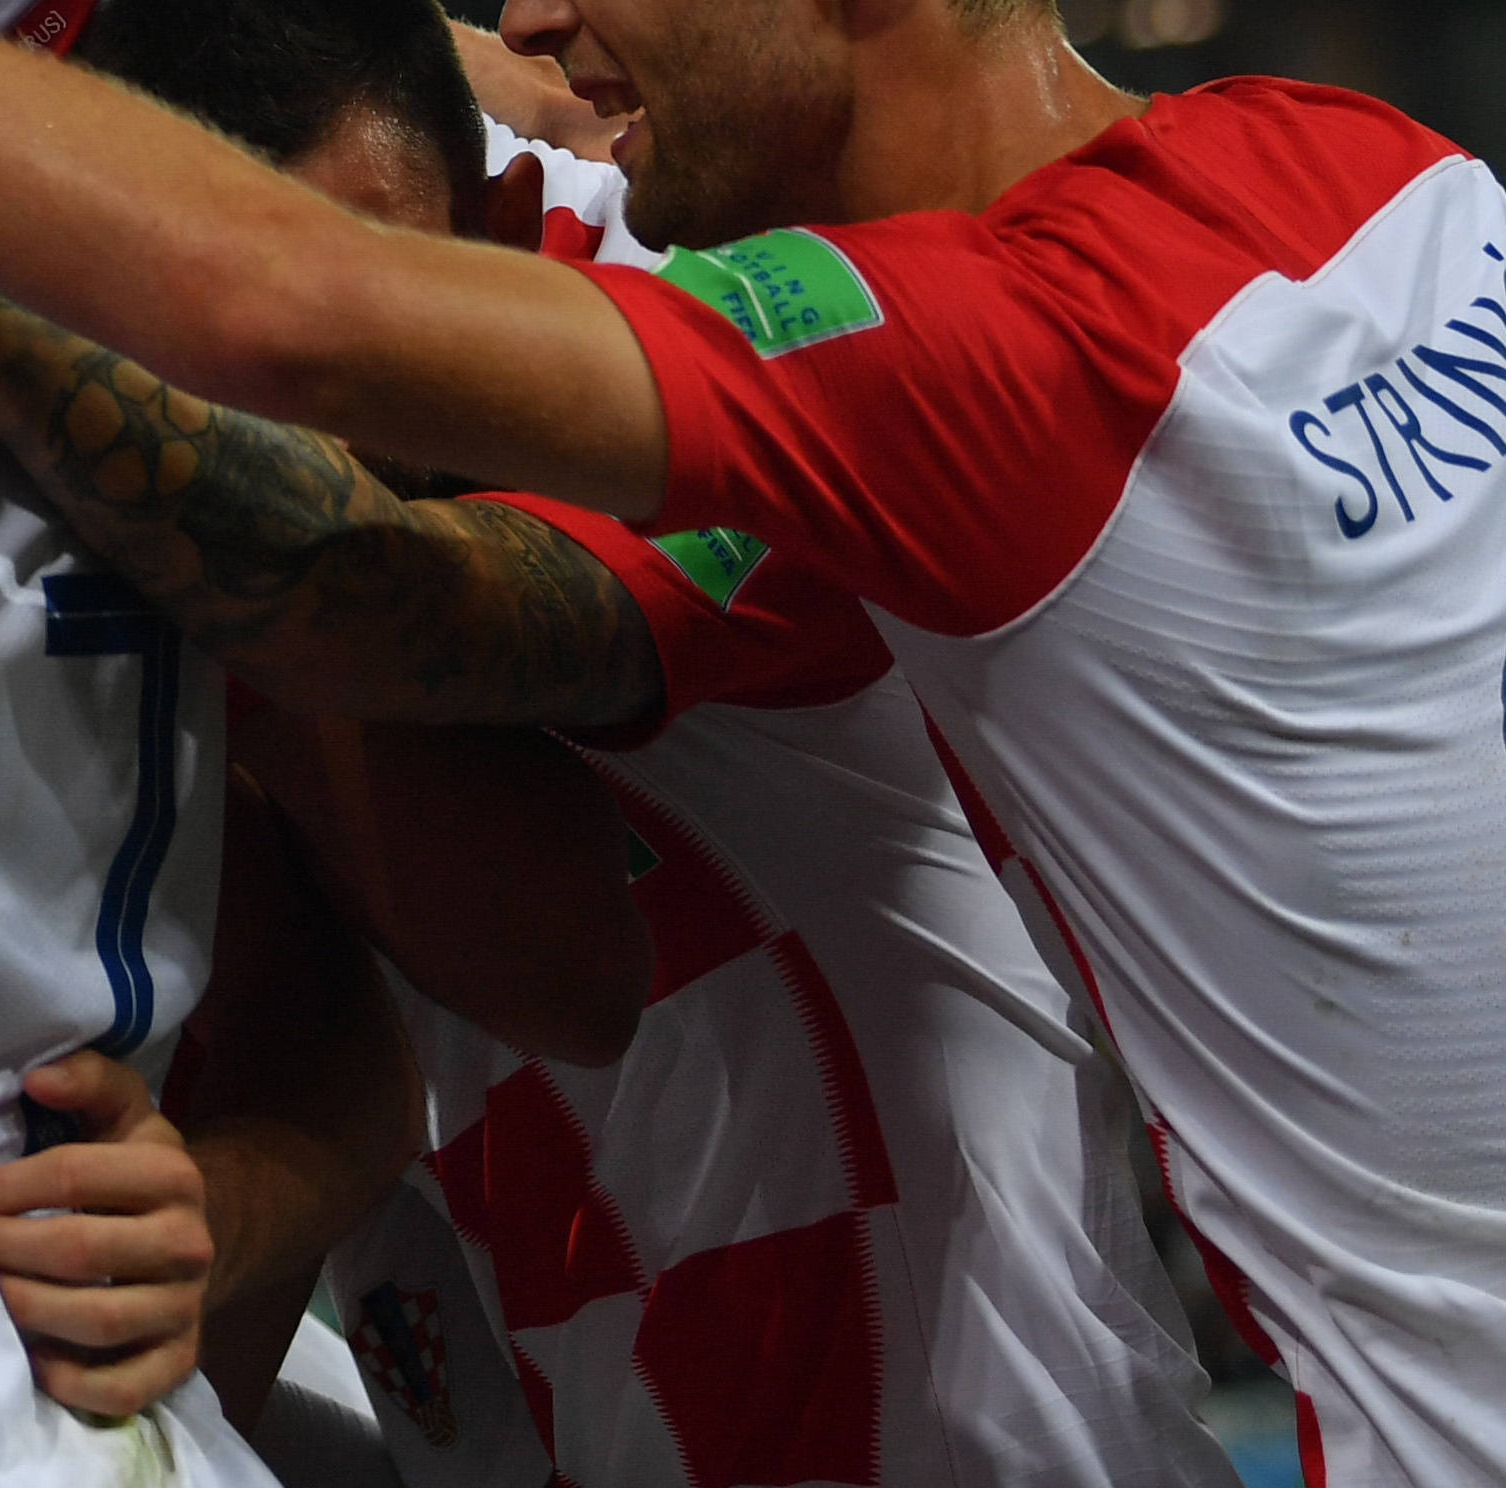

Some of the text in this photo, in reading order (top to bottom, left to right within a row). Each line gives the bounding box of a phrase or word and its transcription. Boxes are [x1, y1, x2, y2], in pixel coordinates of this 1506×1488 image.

[21, 9, 67, 52] RUS)
[756, 250, 821, 326] VING
[1289, 242, 1506, 540] STRIN
